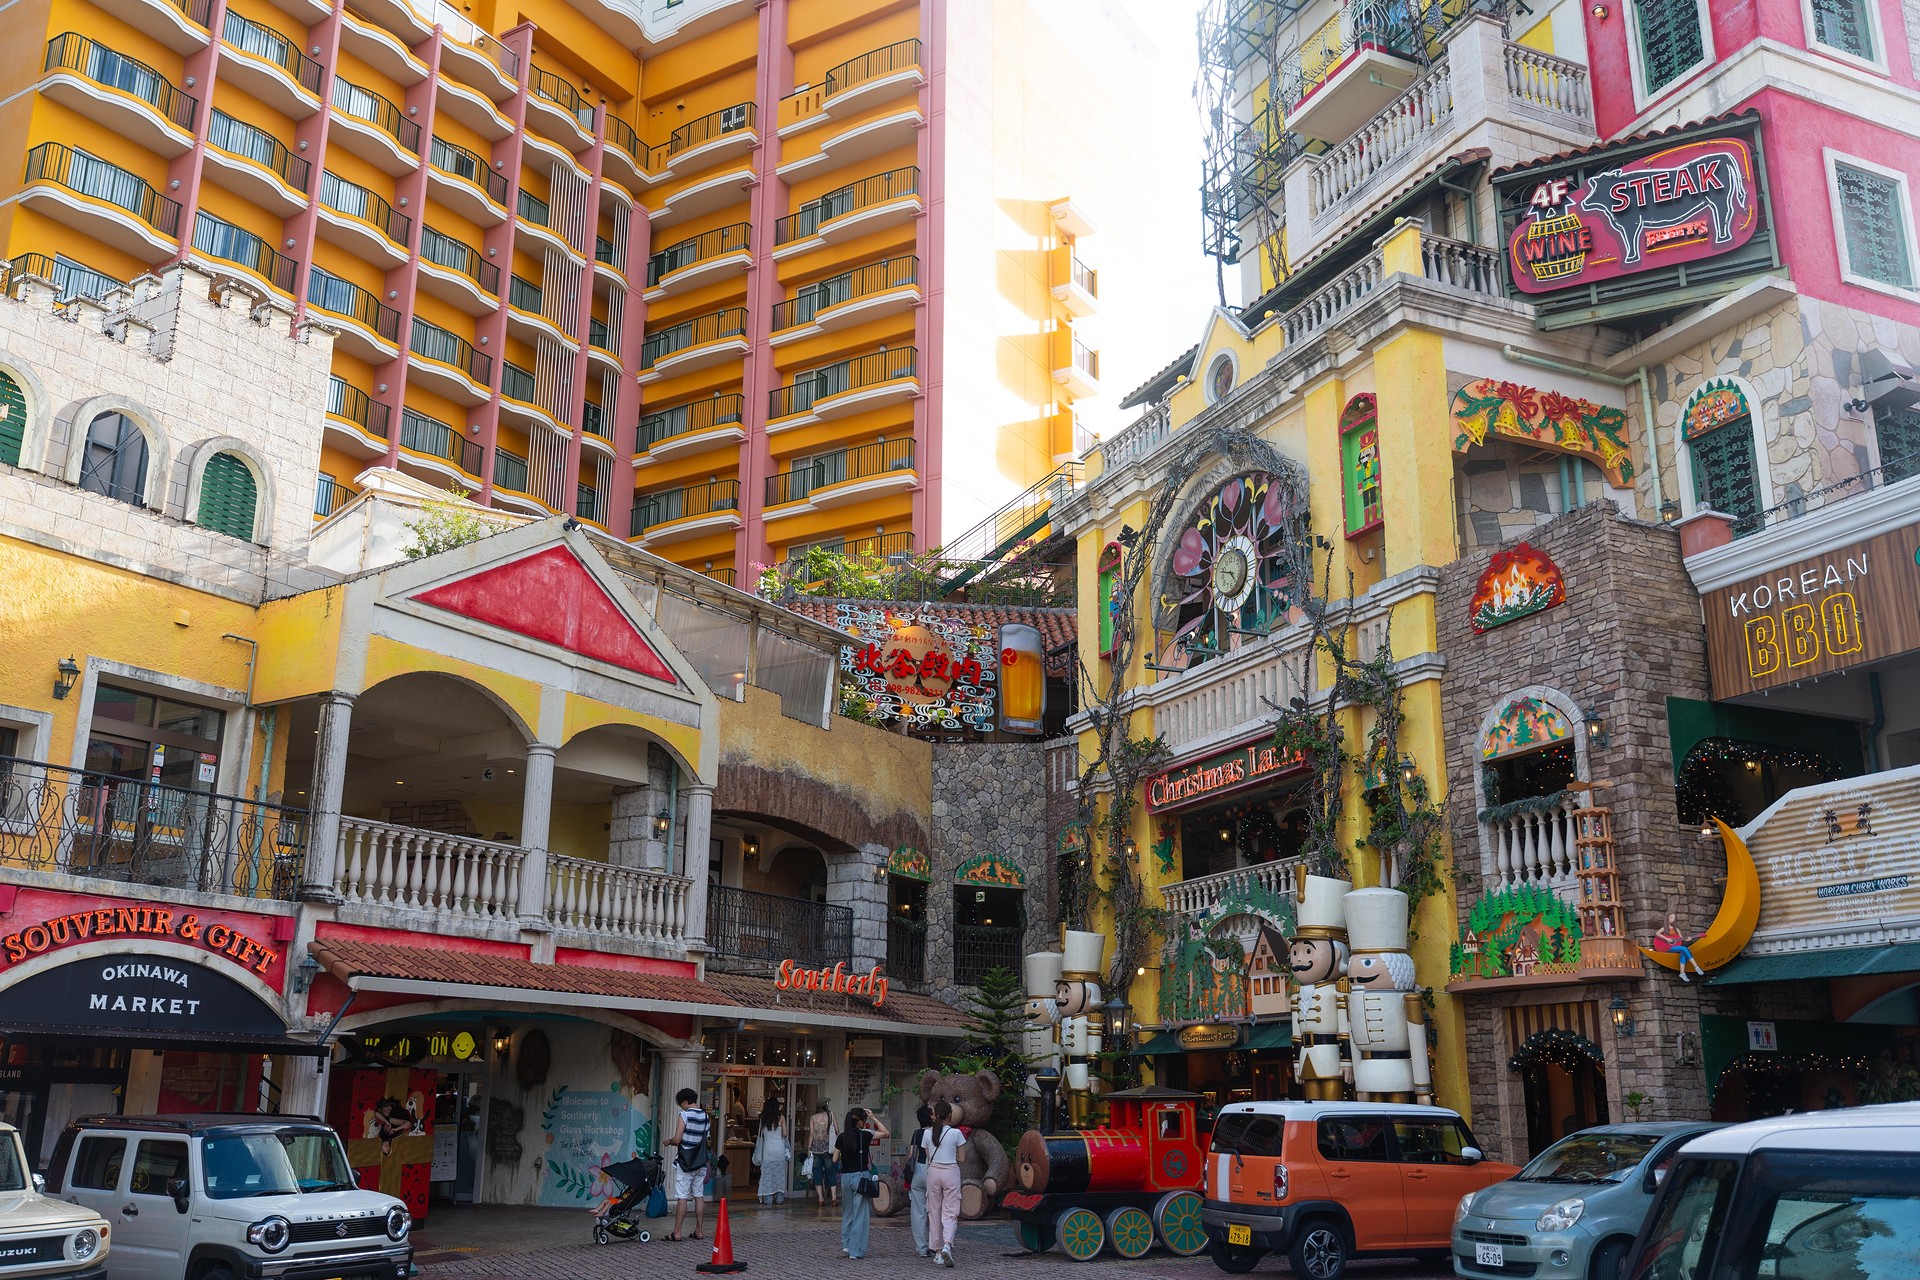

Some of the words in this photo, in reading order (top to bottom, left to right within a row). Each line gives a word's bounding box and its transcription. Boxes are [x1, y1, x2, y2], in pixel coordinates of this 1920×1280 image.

[1532, 179, 1568, 208] 4F
[1611, 160, 1724, 212] STEAK
[1523, 227, 1592, 261] WINE
[1730, 553, 1868, 617] KOREAN
[1744, 592, 1862, 678] BBQ
[856, 643, 982, 685] 北谷殿内
[1150, 759, 1245, 807] Christmas
[1247, 746, 1304, 776] La
[1818, 885, 1850, 898] HORIZON
[1851, 881, 1876, 893] CURRY
[1877, 876, 1908, 889] WORKS
[3, 907, 174, 963] SOUVENIR
[177, 914, 202, 941] &
[203, 924, 277, 974] GIFT
[102, 964, 189, 988] OKINAWA
[774, 959, 888, 1007] Southerly
[89, 994, 200, 1015] MARKET
[748, 1067, 774, 1077] Southerly
[562, 1096, 598, 1106] Welcome
[601, 1097, 609, 1106] to
[560, 1125, 583, 1135] Glass
[584, 1125, 624, 1138] Workshop
[561, 1111, 600, 1123] Southerly
